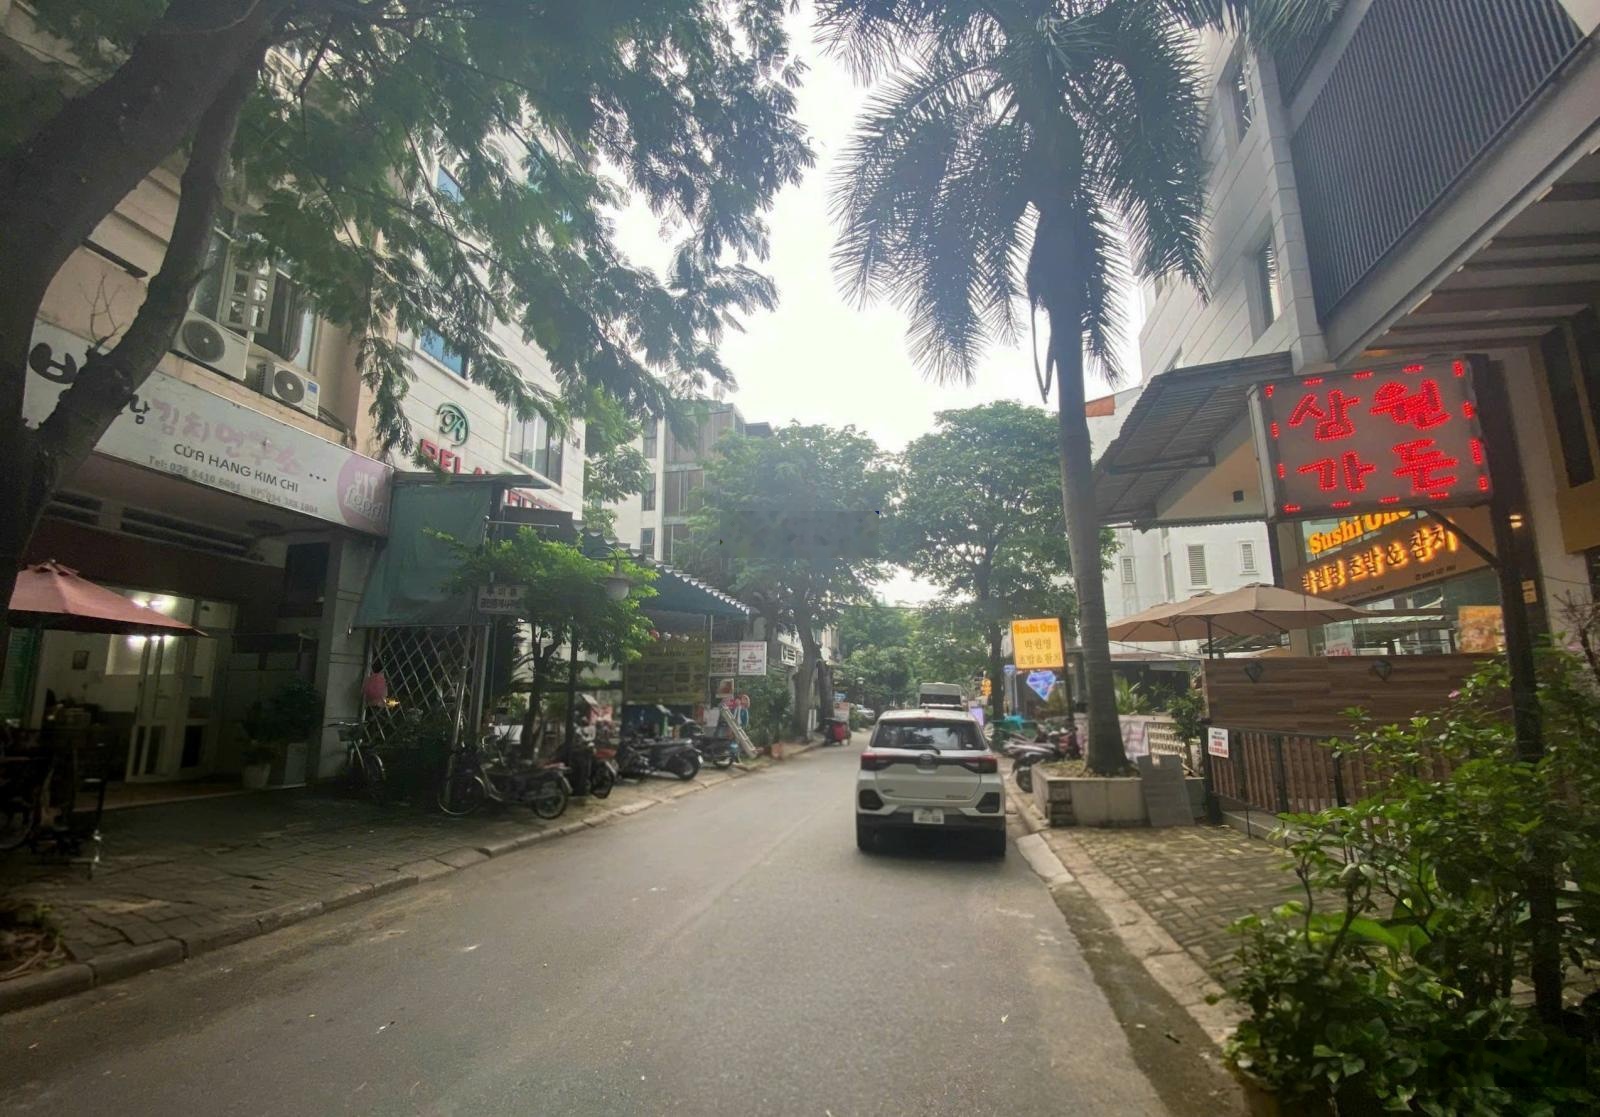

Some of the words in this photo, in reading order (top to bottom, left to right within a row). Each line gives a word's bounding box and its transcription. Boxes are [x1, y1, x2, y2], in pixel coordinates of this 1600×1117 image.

[1288, 379, 1452, 441] 삼원
[254, 469, 277, 487] KIM
[280, 479, 299, 493] CHI
[1296, 439, 1458, 492] 가든
[1308, 515, 1364, 554] Sushi
[1350, 545, 1383, 581] 초밥
[1385, 542, 1407, 567] &
[1409, 524, 1457, 562] 참치
